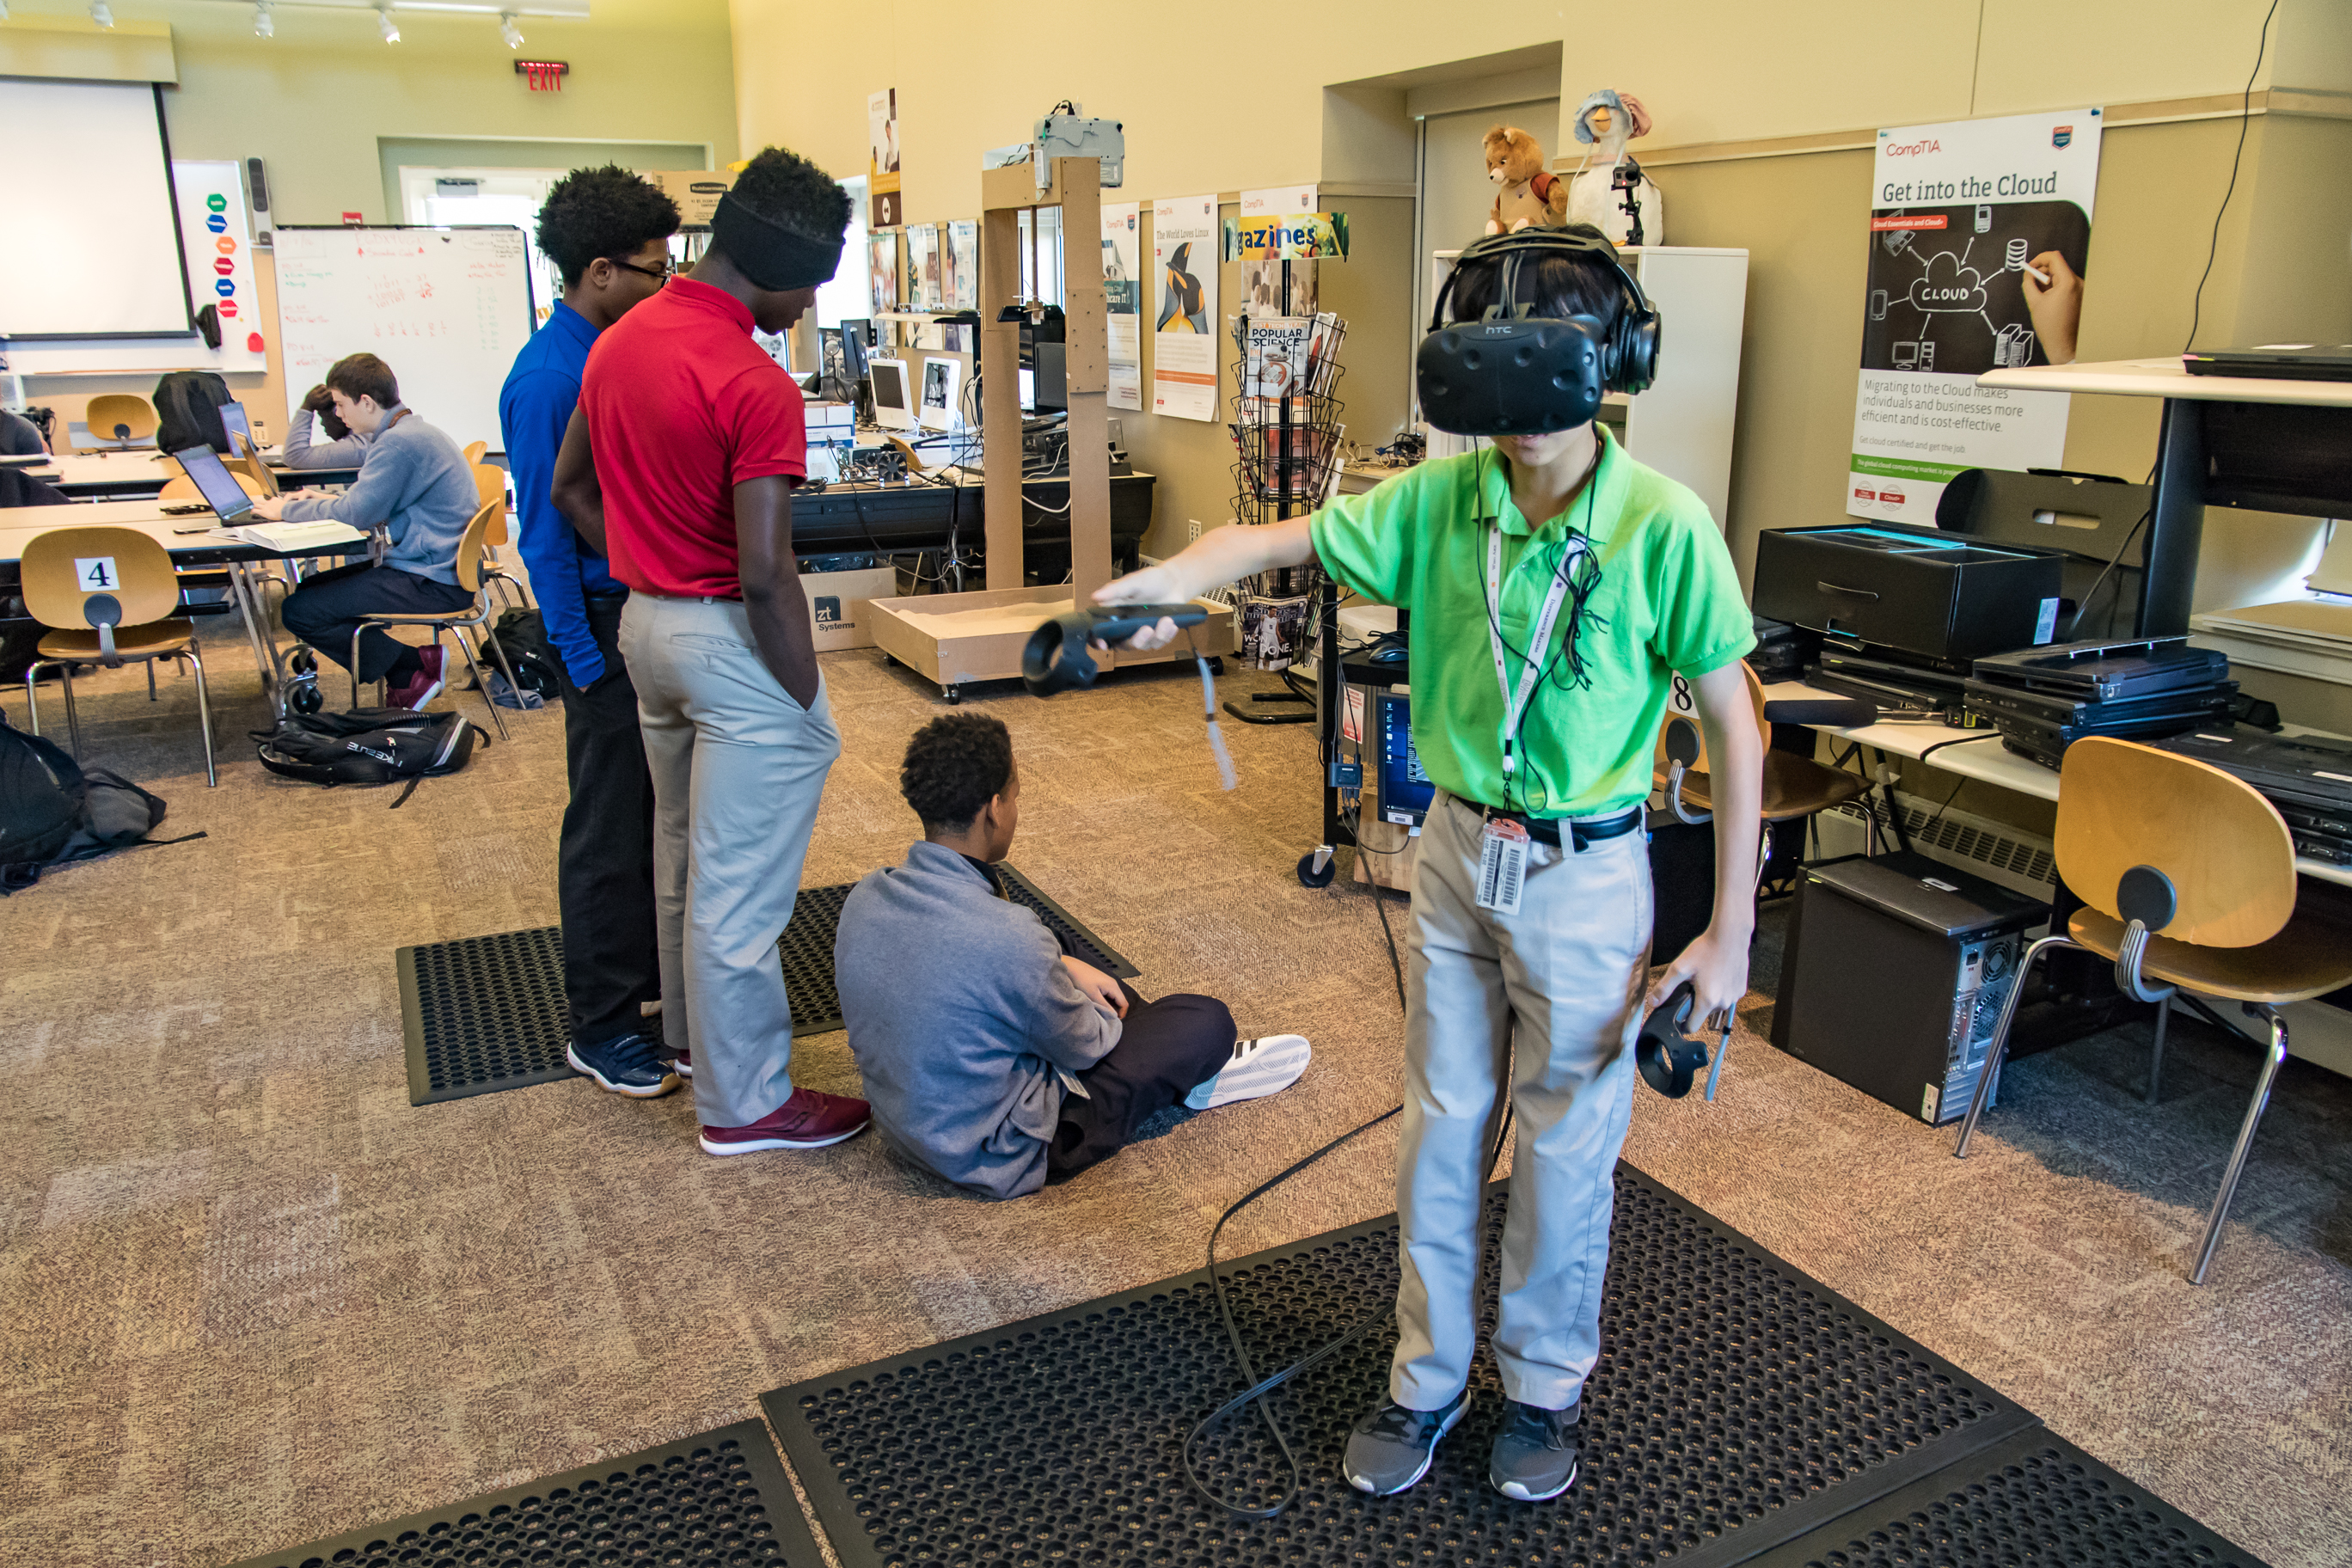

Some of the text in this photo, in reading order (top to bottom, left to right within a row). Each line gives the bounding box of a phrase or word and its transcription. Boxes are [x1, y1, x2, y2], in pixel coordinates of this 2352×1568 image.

[527, 67, 561, 91] EXIT
[1885, 139, 1941, 157] CompTIA
[1883, 171, 2057, 202] Get into the Cloud
[1156, 207, 1173, 216] CompTIA
[1244, 199, 1265, 208] CompTIA
[1106, 220, 1124, 229] CompTIA
[1156, 228, 1210, 240] The World Loves Linux
[1236, 224, 1316, 256] gazines
[1921, 287, 1969, 301] CLOUD
[1252, 328, 1302, 339] POPULAR
[1253, 338, 1300, 346] SCIENCE
[1865, 379, 2008, 399] Migrating to the Cloud makes
[1863, 395, 2024, 417] individuals and businesses more
[1861, 410, 2003, 432] efficient and is cost-effective.
[1859, 435, 1869, 444] Get
[1869, 437, 1886, 445] cloud
[1886, 439, 1914, 449] certified
[1915, 441, 1927, 450] and
[1928, 444, 1940, 452] get
[1941, 443, 1953, 452] the
[88, 561, 111, 587] 4
[817, 606, 832, 621] zt
[818, 622, 855, 632] Systems
[1673, 676, 1693, 711] 8
